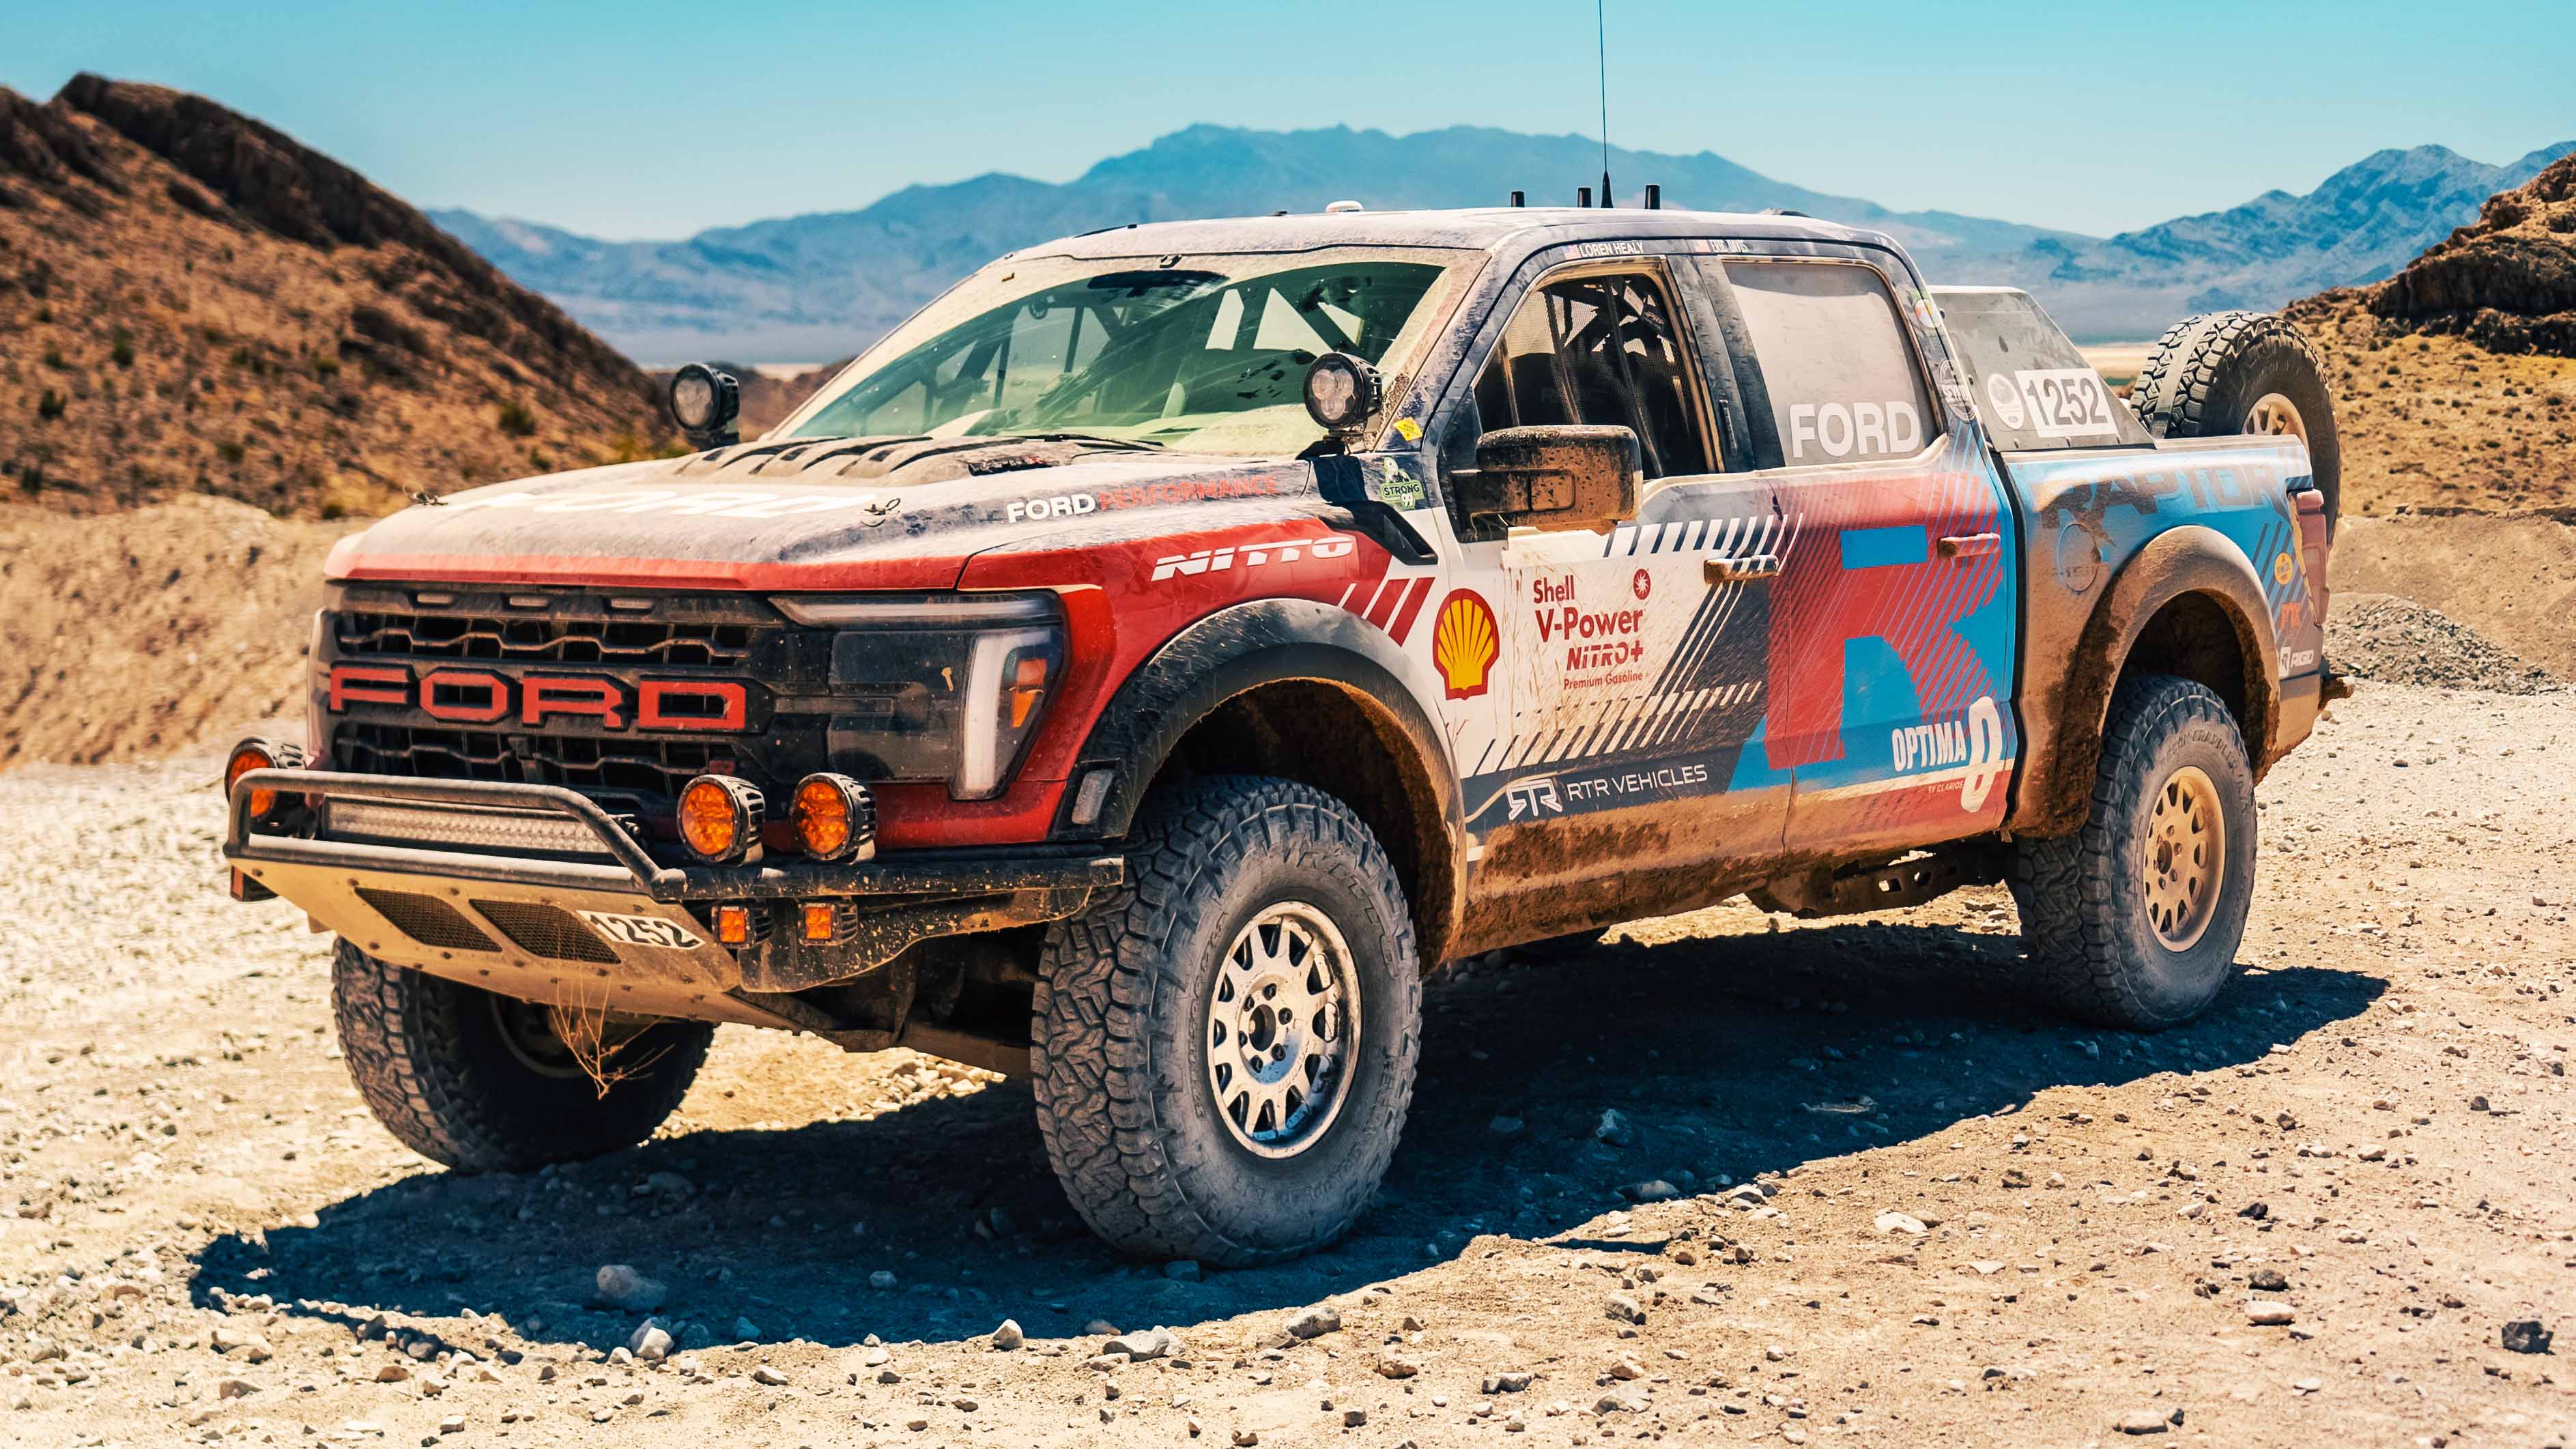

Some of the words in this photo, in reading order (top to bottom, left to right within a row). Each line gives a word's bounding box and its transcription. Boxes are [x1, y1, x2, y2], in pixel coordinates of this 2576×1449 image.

[1579, 242, 1613, 257] LOREN
[1613, 242, 1644, 254] HEALY
[2025, 377, 2108, 426] 1252
[1789, 401, 1921, 459] FORD
[1006, 493, 1096, 523] FORD
[1098, 474, 1279, 511] PERFORMANCE
[1384, 484, 1420, 496] STRONG
[2030, 464, 2291, 547] RAPTOR
[1150, 536, 1353, 582] NITTO
[1533, 575, 1575, 604] Shell
[1534, 606, 1644, 643] V-Power
[330, 667, 747, 730] FORD
[1563, 676, 1603, 690] Premium
[1605, 670, 1644, 686] Gasoline
[1891, 720, 1967, 772] OPTIMA
[1566, 777, 1611, 801] RTR
[1611, 764, 1708, 794] VEHICLES
[589, 914, 702, 948] 1252
